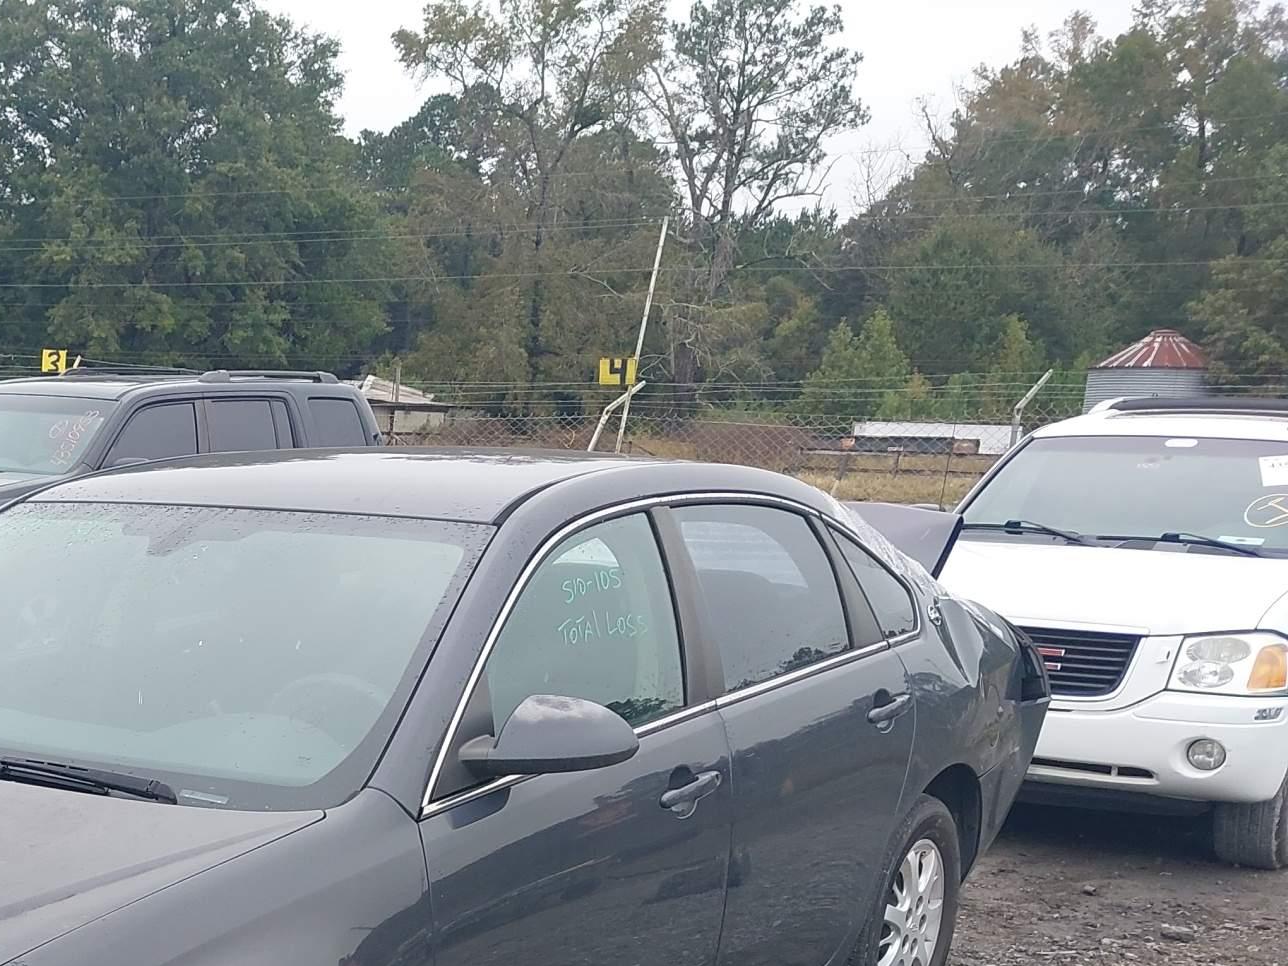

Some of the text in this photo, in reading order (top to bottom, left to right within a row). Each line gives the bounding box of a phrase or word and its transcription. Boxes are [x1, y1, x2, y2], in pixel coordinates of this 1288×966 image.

[47, 351, 61, 372] 3
[609, 358, 628, 386] 4
[606, 611, 649, 637] LOSS
